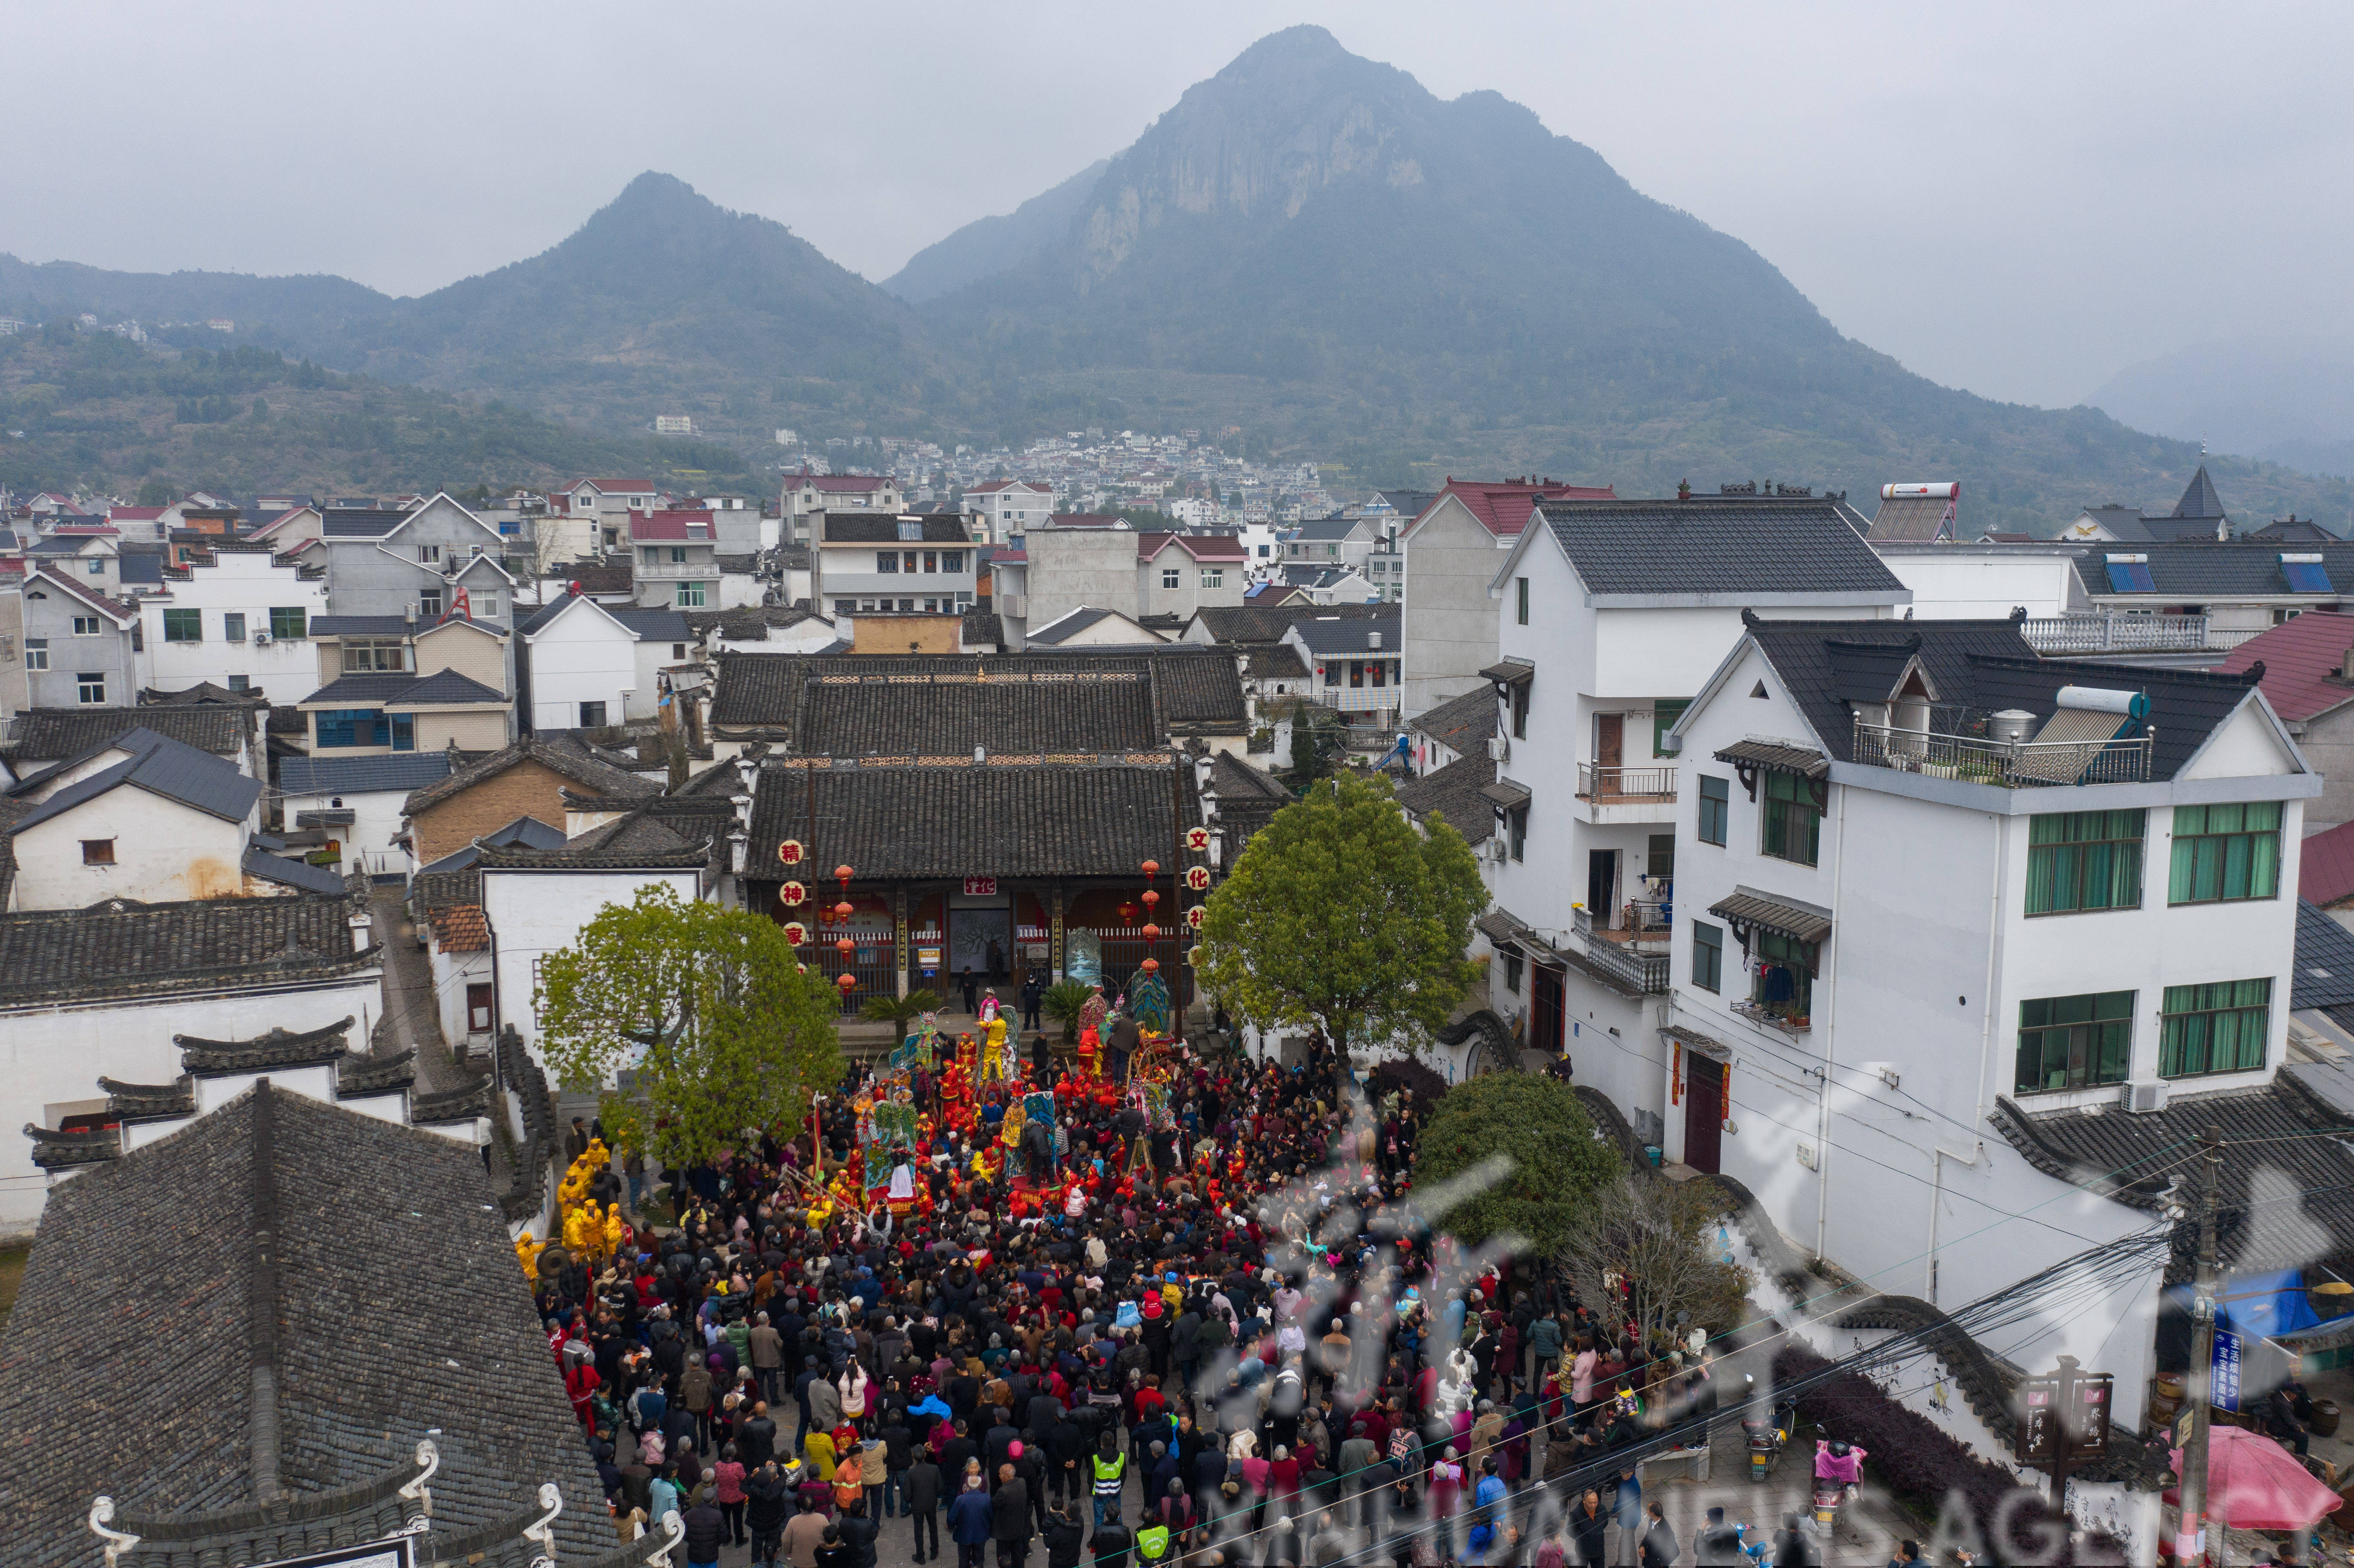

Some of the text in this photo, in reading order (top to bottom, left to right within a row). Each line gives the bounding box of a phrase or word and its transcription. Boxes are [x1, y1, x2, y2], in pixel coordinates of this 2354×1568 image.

[782, 844, 804, 974] 精神家
[1189, 831, 1208, 965] 文化礼
[2217, 1347, 2229, 1407] 宝宝素质高
[2229, 1338, 2240, 1397] 生活烦恼少
[2089, 1407, 2102, 1437] 界路
